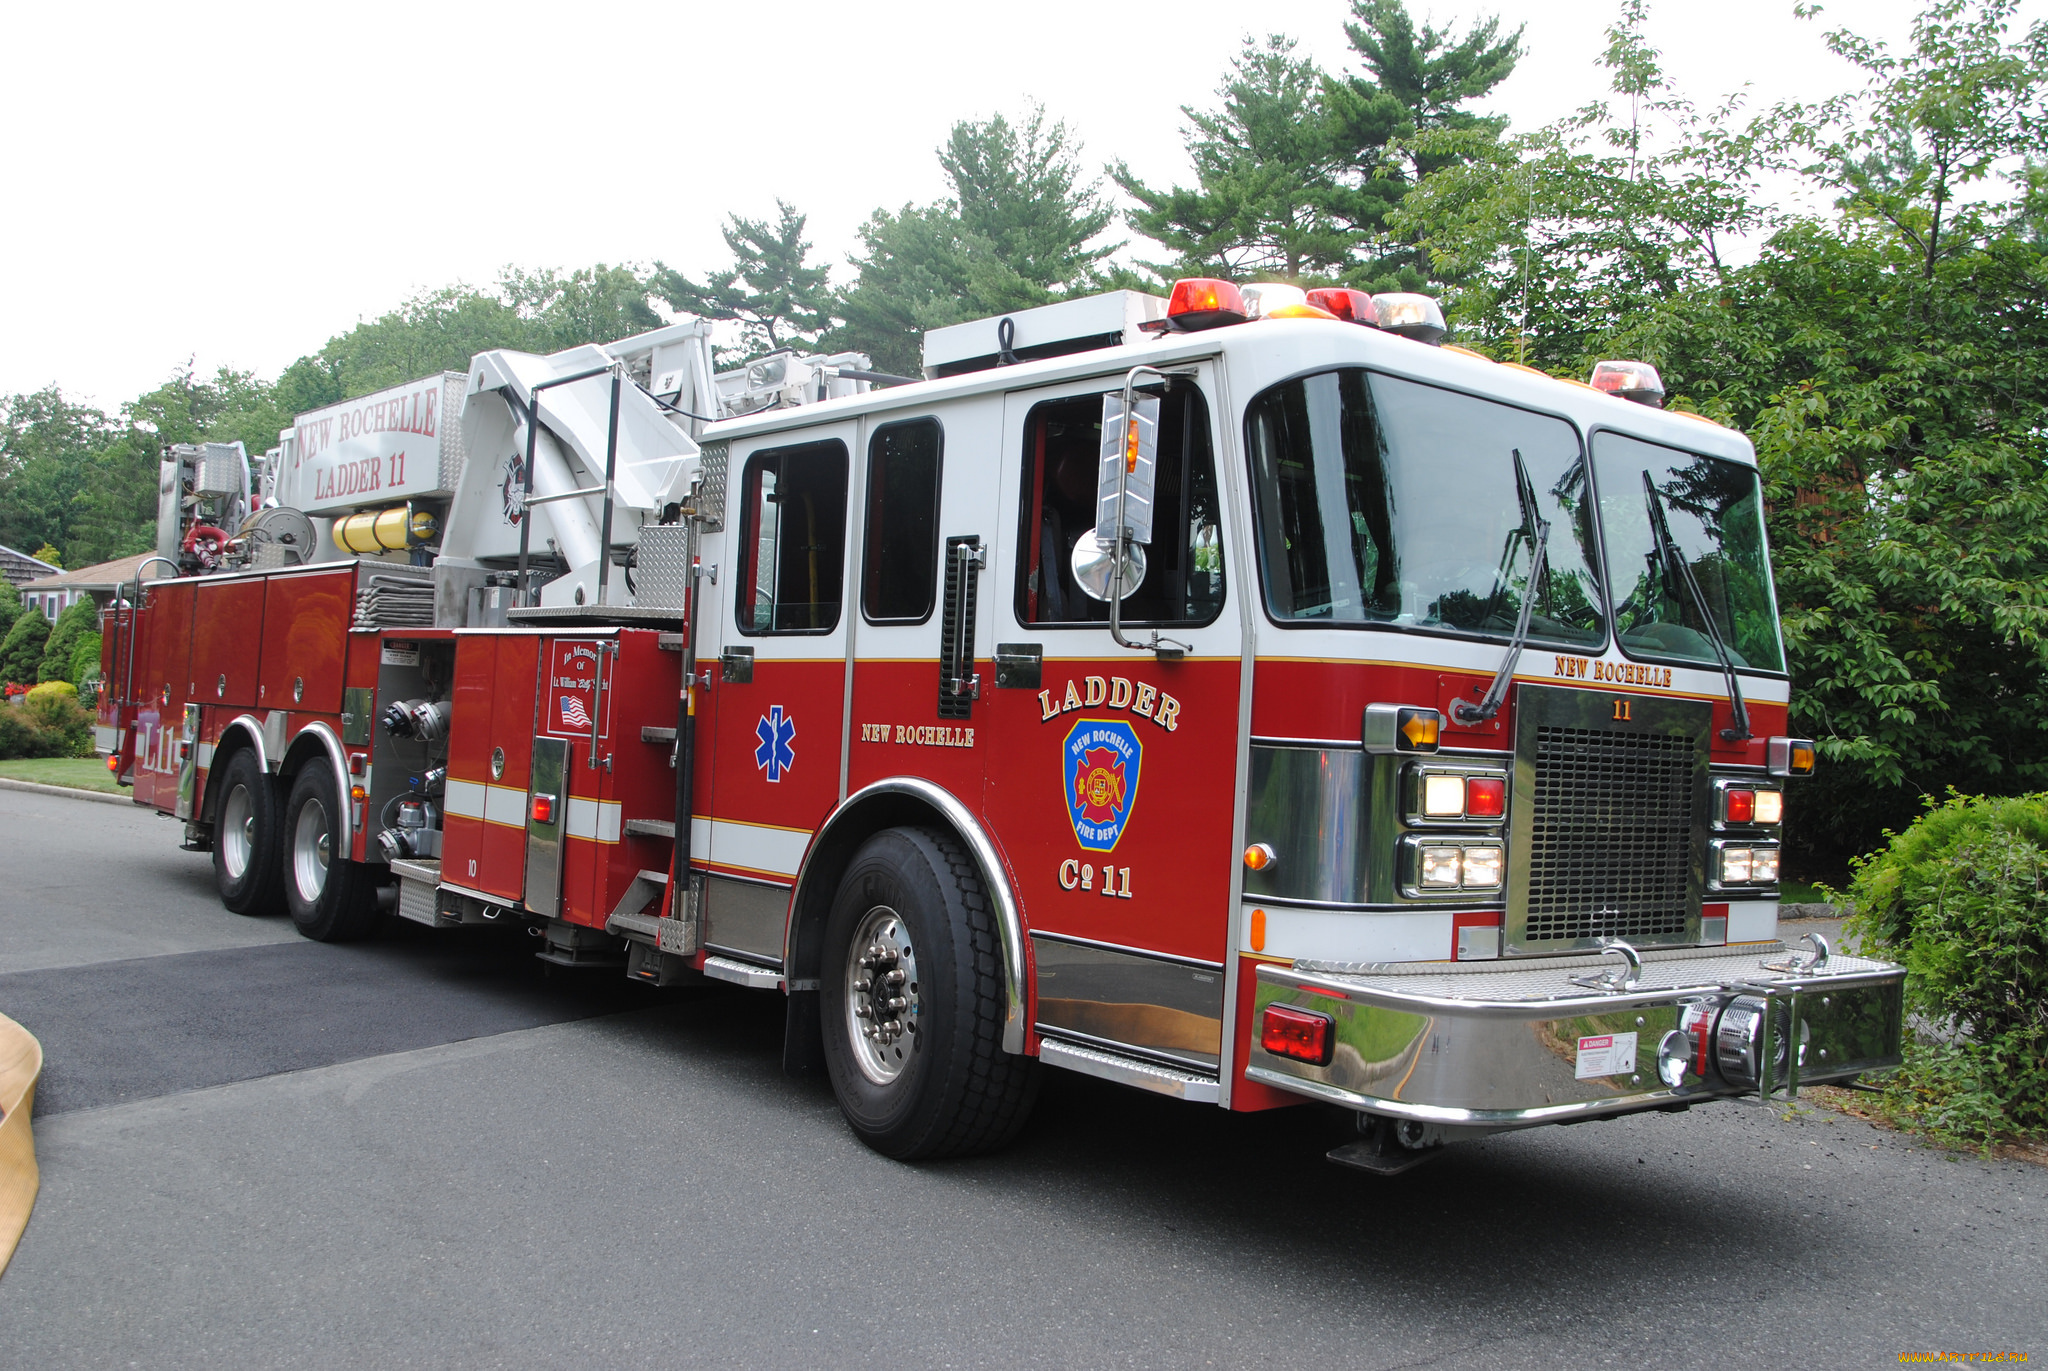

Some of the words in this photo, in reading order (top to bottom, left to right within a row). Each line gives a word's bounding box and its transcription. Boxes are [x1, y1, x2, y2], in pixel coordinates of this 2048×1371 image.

[295, 417, 333, 468] NEW
[338, 388, 437, 442] ROCHELLE
[314, 456, 382, 500] LADDER
[388, 451, 405, 487] 11
[563, 652, 572, 666] In
[573, 645, 597, 661] Memor
[577, 661, 586, 670] Of
[1555, 655, 1588, 678] NEW
[1594, 660, 1672, 687] ROCHELLE
[1038, 675, 1181, 733] LADDER
[1613, 700, 1631, 720] 11
[142, 722, 174, 775] L11
[861, 724, 891, 742] NEW
[895, 725, 975, 747] ROCHELLE
[1071, 732, 1091, 756] NEW
[1092, 730, 1133, 759] ROCHELLE
[1076, 820, 1095, 840] FIRE
[1097, 824, 1119, 841] DEPT
[468, 859, 477, 878] 10
[1102, 865, 1132, 898] 11
[1588, 1038, 1610, 1048] DANGER
